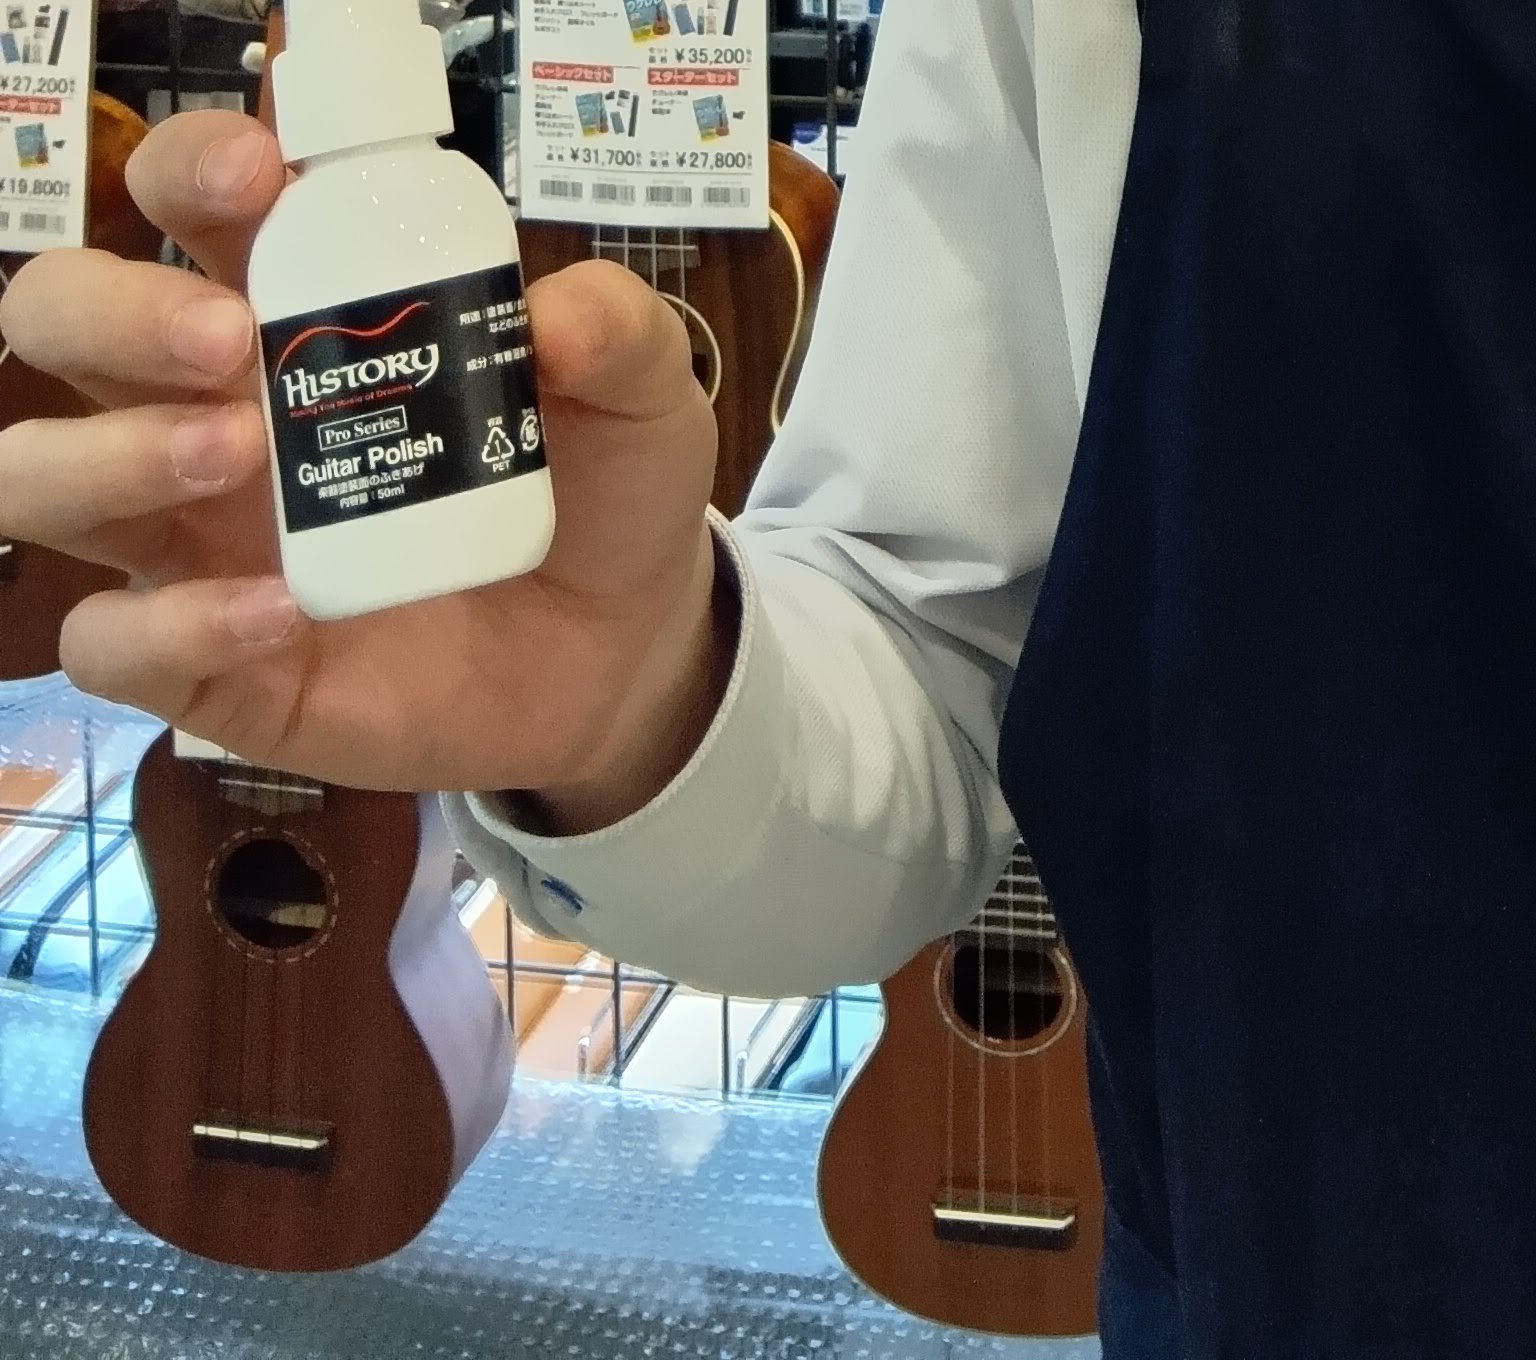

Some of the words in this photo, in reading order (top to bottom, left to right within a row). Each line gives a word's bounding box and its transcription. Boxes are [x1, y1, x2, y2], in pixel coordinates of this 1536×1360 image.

[675, 48, 745, 66] ¥35,200
[535, 65, 612, 80] ベーシックセット
[651, 70, 736, 84] スターターセット
[570, 147, 635, 167] ¥31,700
[676, 152, 745, 170] ¥27,800
[324, 427, 350, 445] Pro
[354, 416, 400, 438] Series
[298, 456, 361, 486] Guitar
[368, 433, 444, 469] Polish
[492, 461, 511, 473] PET
